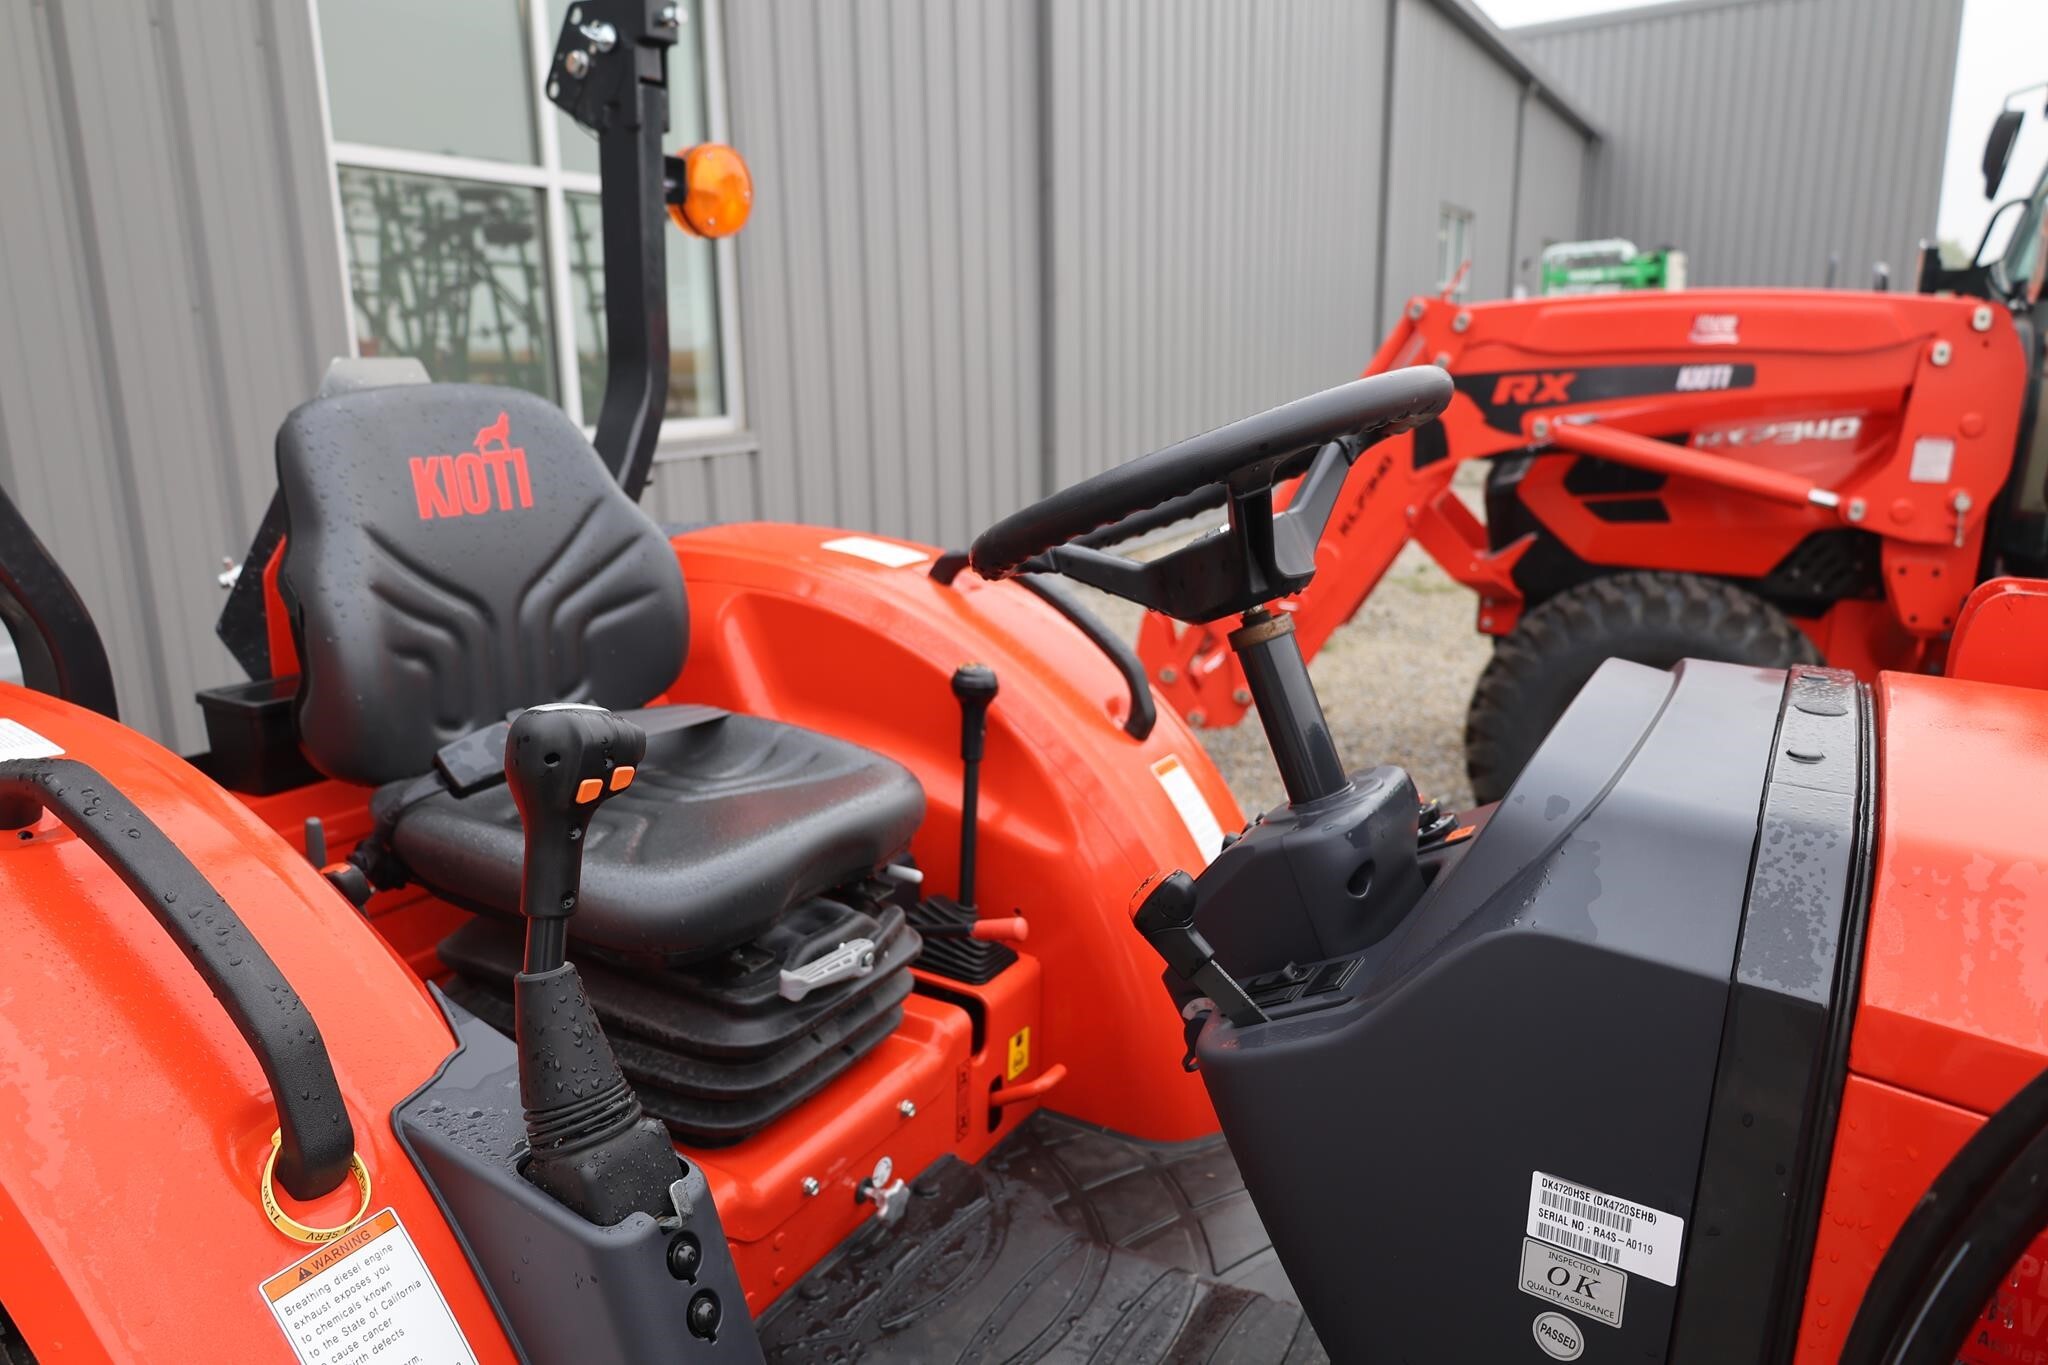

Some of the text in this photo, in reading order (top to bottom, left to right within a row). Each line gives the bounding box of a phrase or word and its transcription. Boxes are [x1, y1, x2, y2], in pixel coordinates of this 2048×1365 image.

[1492, 373, 1575, 405] RX
[408, 448, 534, 520] KIOTI
[1538, 1207, 1569, 1226] SERIAL
[1541, 1177, 1658, 1226] DK4720HSE (DK4720SEHB)
[311, 1230, 372, 1271] WARNING
[1548, 1251, 1601, 1276] INSPECTION
[284, 1243, 394, 1317] Breathing diesel engine
[293, 1264, 391, 1330] exhaust exposes you
[1526, 1279, 1615, 1319] QUALITY ASSURANCE
[1547, 1266, 1602, 1300] OK
[301, 1280, 393, 1344] to chemicals known
[309, 1280, 422, 1359] to the State of California
[331, 1318, 394, 1364] cause cancer
[372, 1328, 405, 1355] defects
[1540, 1323, 1577, 1351] PASSED
